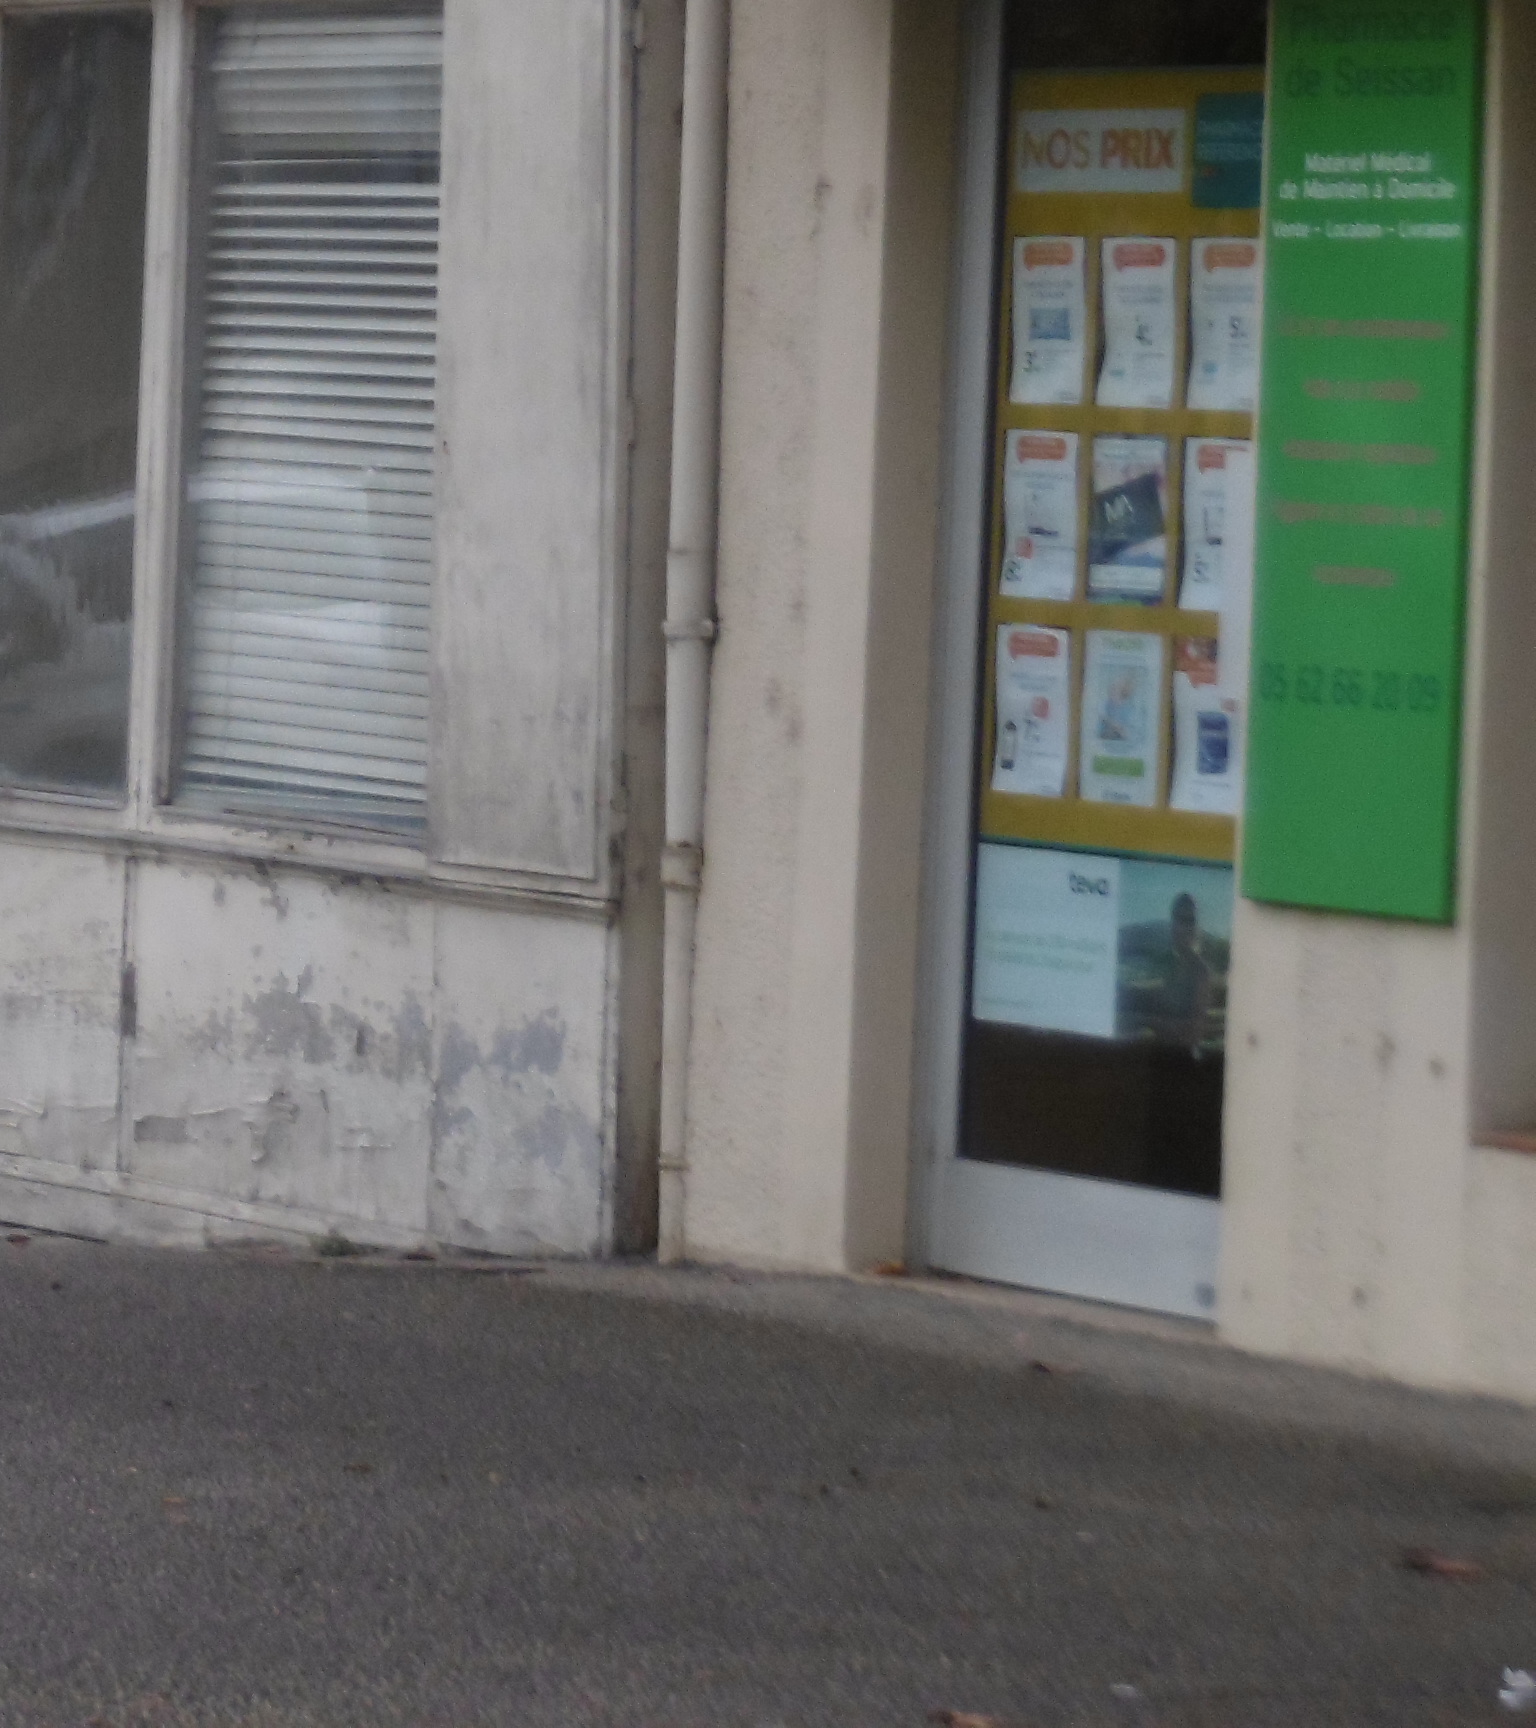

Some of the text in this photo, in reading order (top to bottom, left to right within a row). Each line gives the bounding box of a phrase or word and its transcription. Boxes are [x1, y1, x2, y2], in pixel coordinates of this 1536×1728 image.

[1289, 3, 1456, 44] Pharmacie
[1285, 56, 1456, 99] de Seissan
[1022, 129, 1089, 169] NOS
[1101, 128, 1175, 169] PRIX
[1068, 872, 1110, 896] teva
